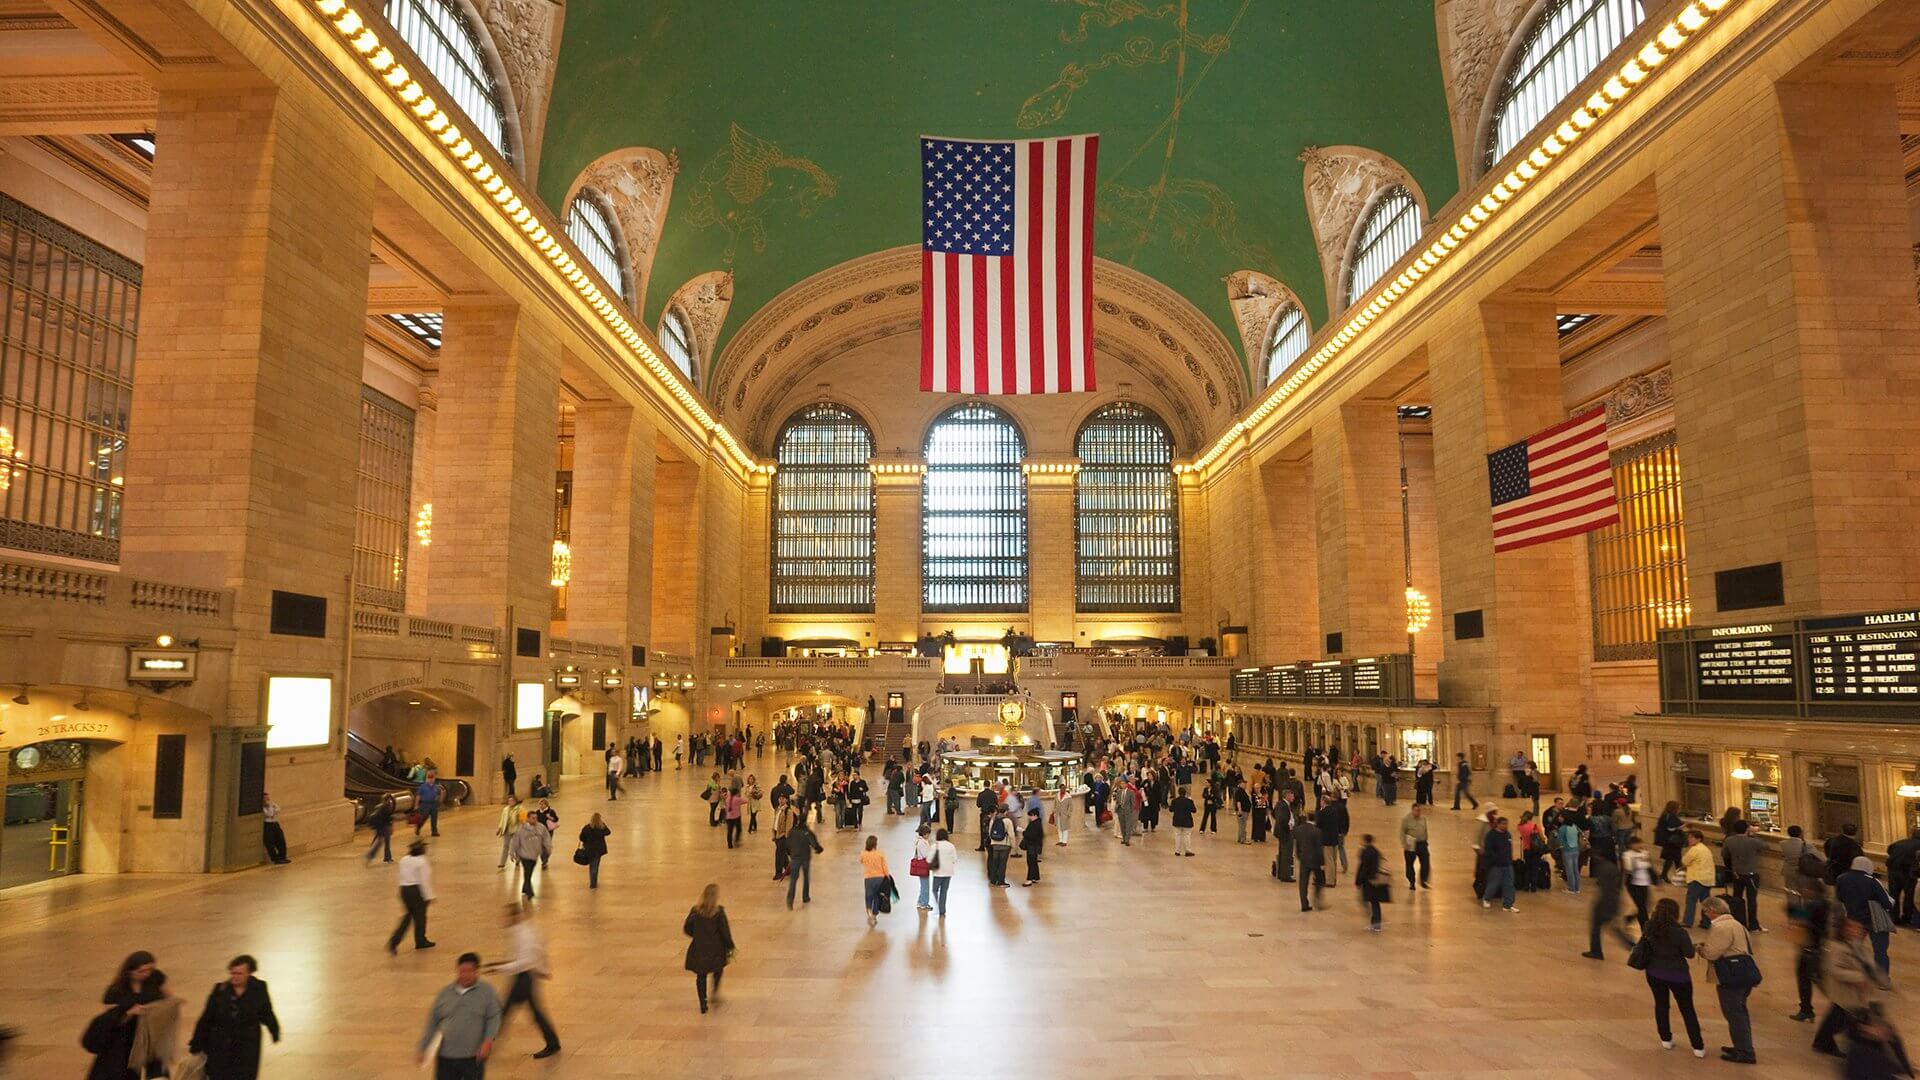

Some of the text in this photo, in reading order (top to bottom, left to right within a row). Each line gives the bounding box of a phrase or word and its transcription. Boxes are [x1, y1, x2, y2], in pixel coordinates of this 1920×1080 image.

[1865, 613, 1915, 625] HARLEM
[1712, 625, 1773, 636] INFORMATION
[1857, 630, 1918, 641] DESTINATION
[1814, 656, 1832, 664] 11:55
[1888, 653, 1915, 661] PLAINS
[1889, 664, 1916, 672] PLAINS
[362, 681, 392, 698] METLIFE
[392, 677, 423, 689] BUILDING
[37, 722, 109, 736] 28 TRACKS 27
